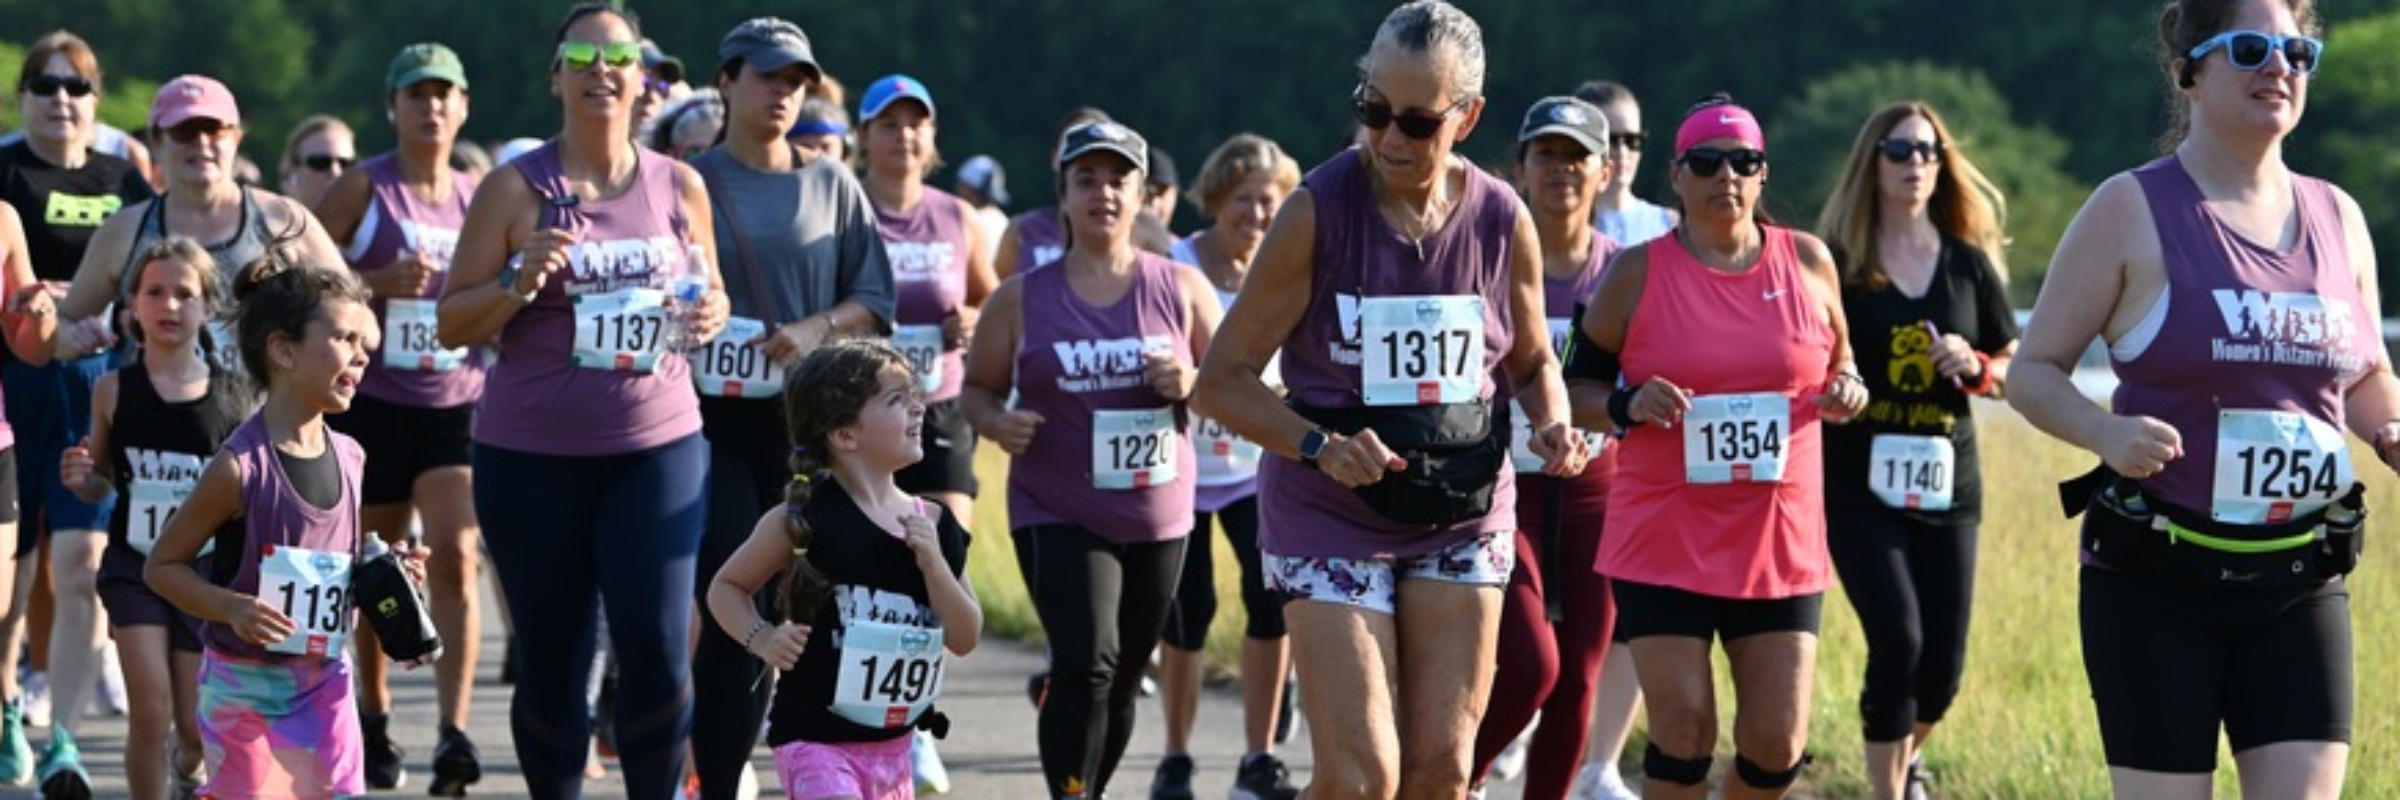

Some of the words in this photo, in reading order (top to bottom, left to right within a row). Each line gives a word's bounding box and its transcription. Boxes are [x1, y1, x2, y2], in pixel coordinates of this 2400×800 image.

[592, 314, 662, 352] 1137
[1382, 330, 1471, 378] 1317
[702, 341, 772, 381] 1601
[1700, 419, 1781, 461] 1354
[1884, 458, 1945, 492] 1140
[2237, 446, 2338, 499] 1254
[860, 655, 943, 703] 1491
